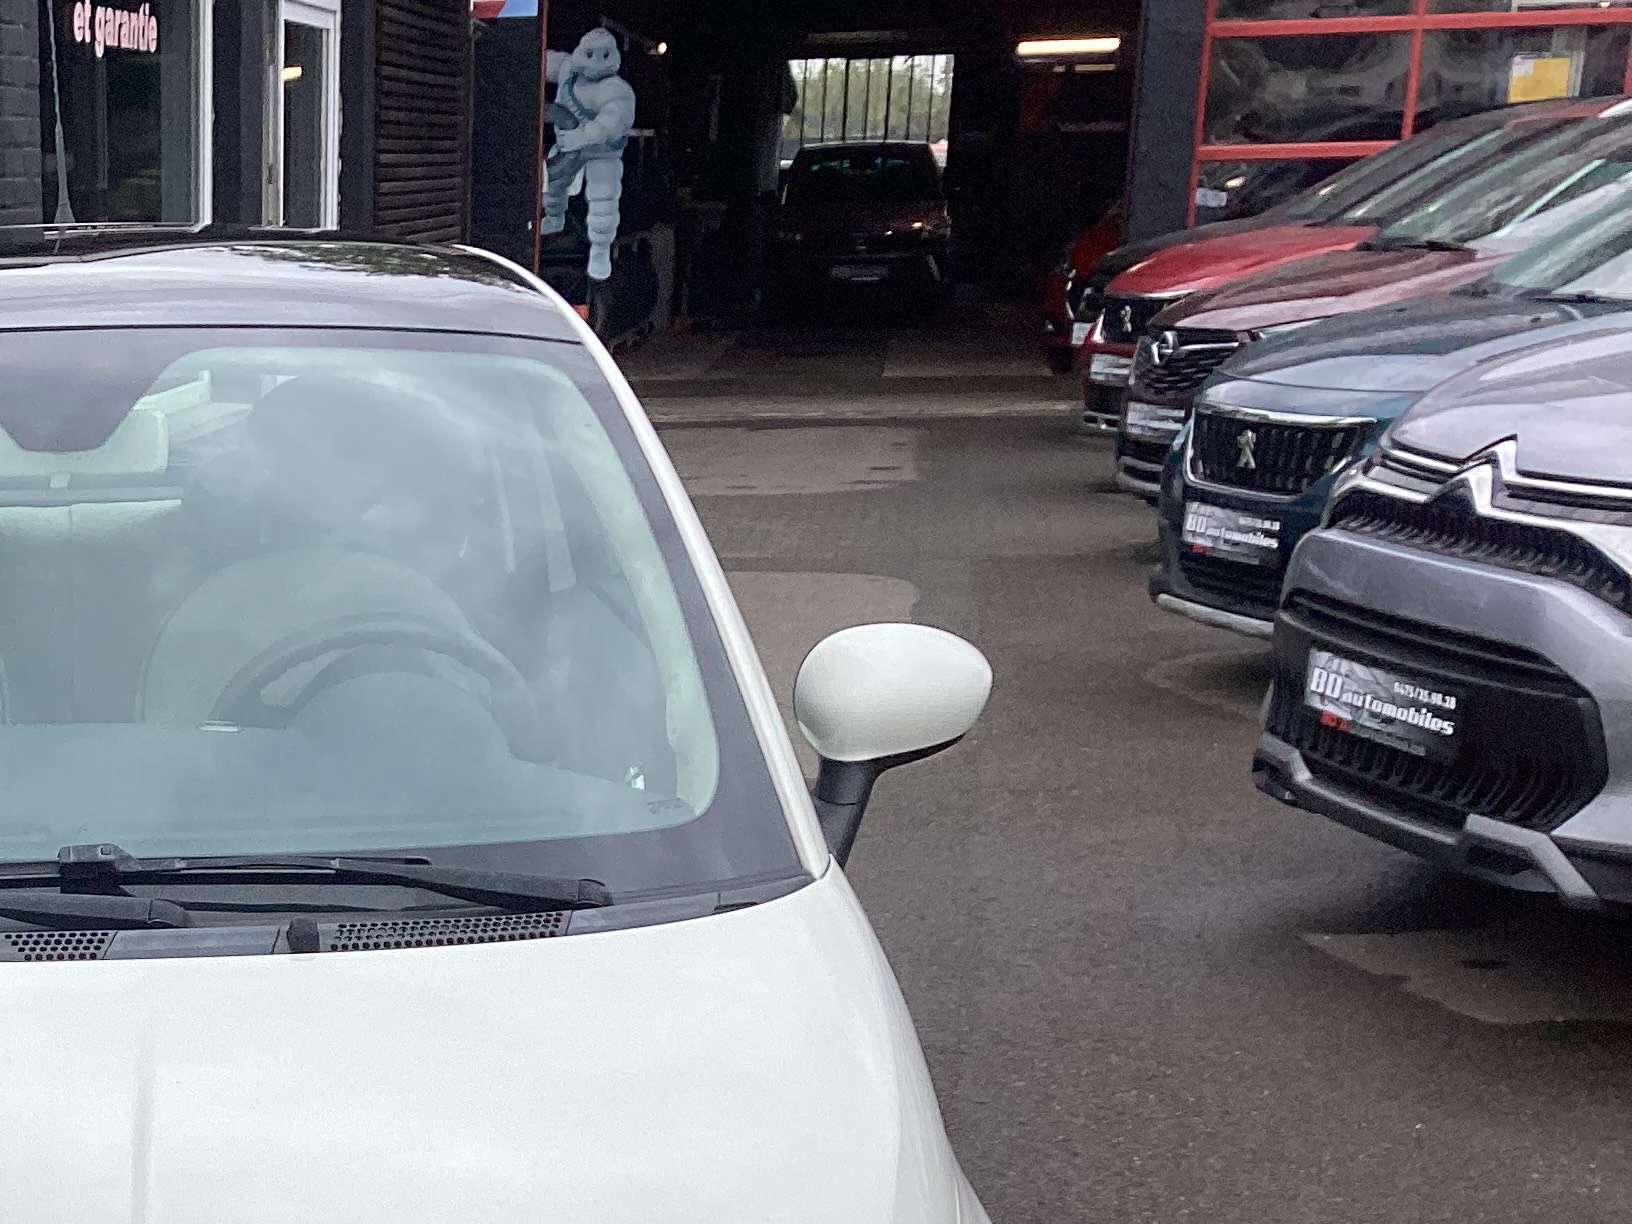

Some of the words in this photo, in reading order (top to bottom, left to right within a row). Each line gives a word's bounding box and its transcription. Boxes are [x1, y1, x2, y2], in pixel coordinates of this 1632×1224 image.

[73, 0, 92, 43] et
[94, 2, 158, 57] garantie
[1341, 692, 1456, 735] automobiles
